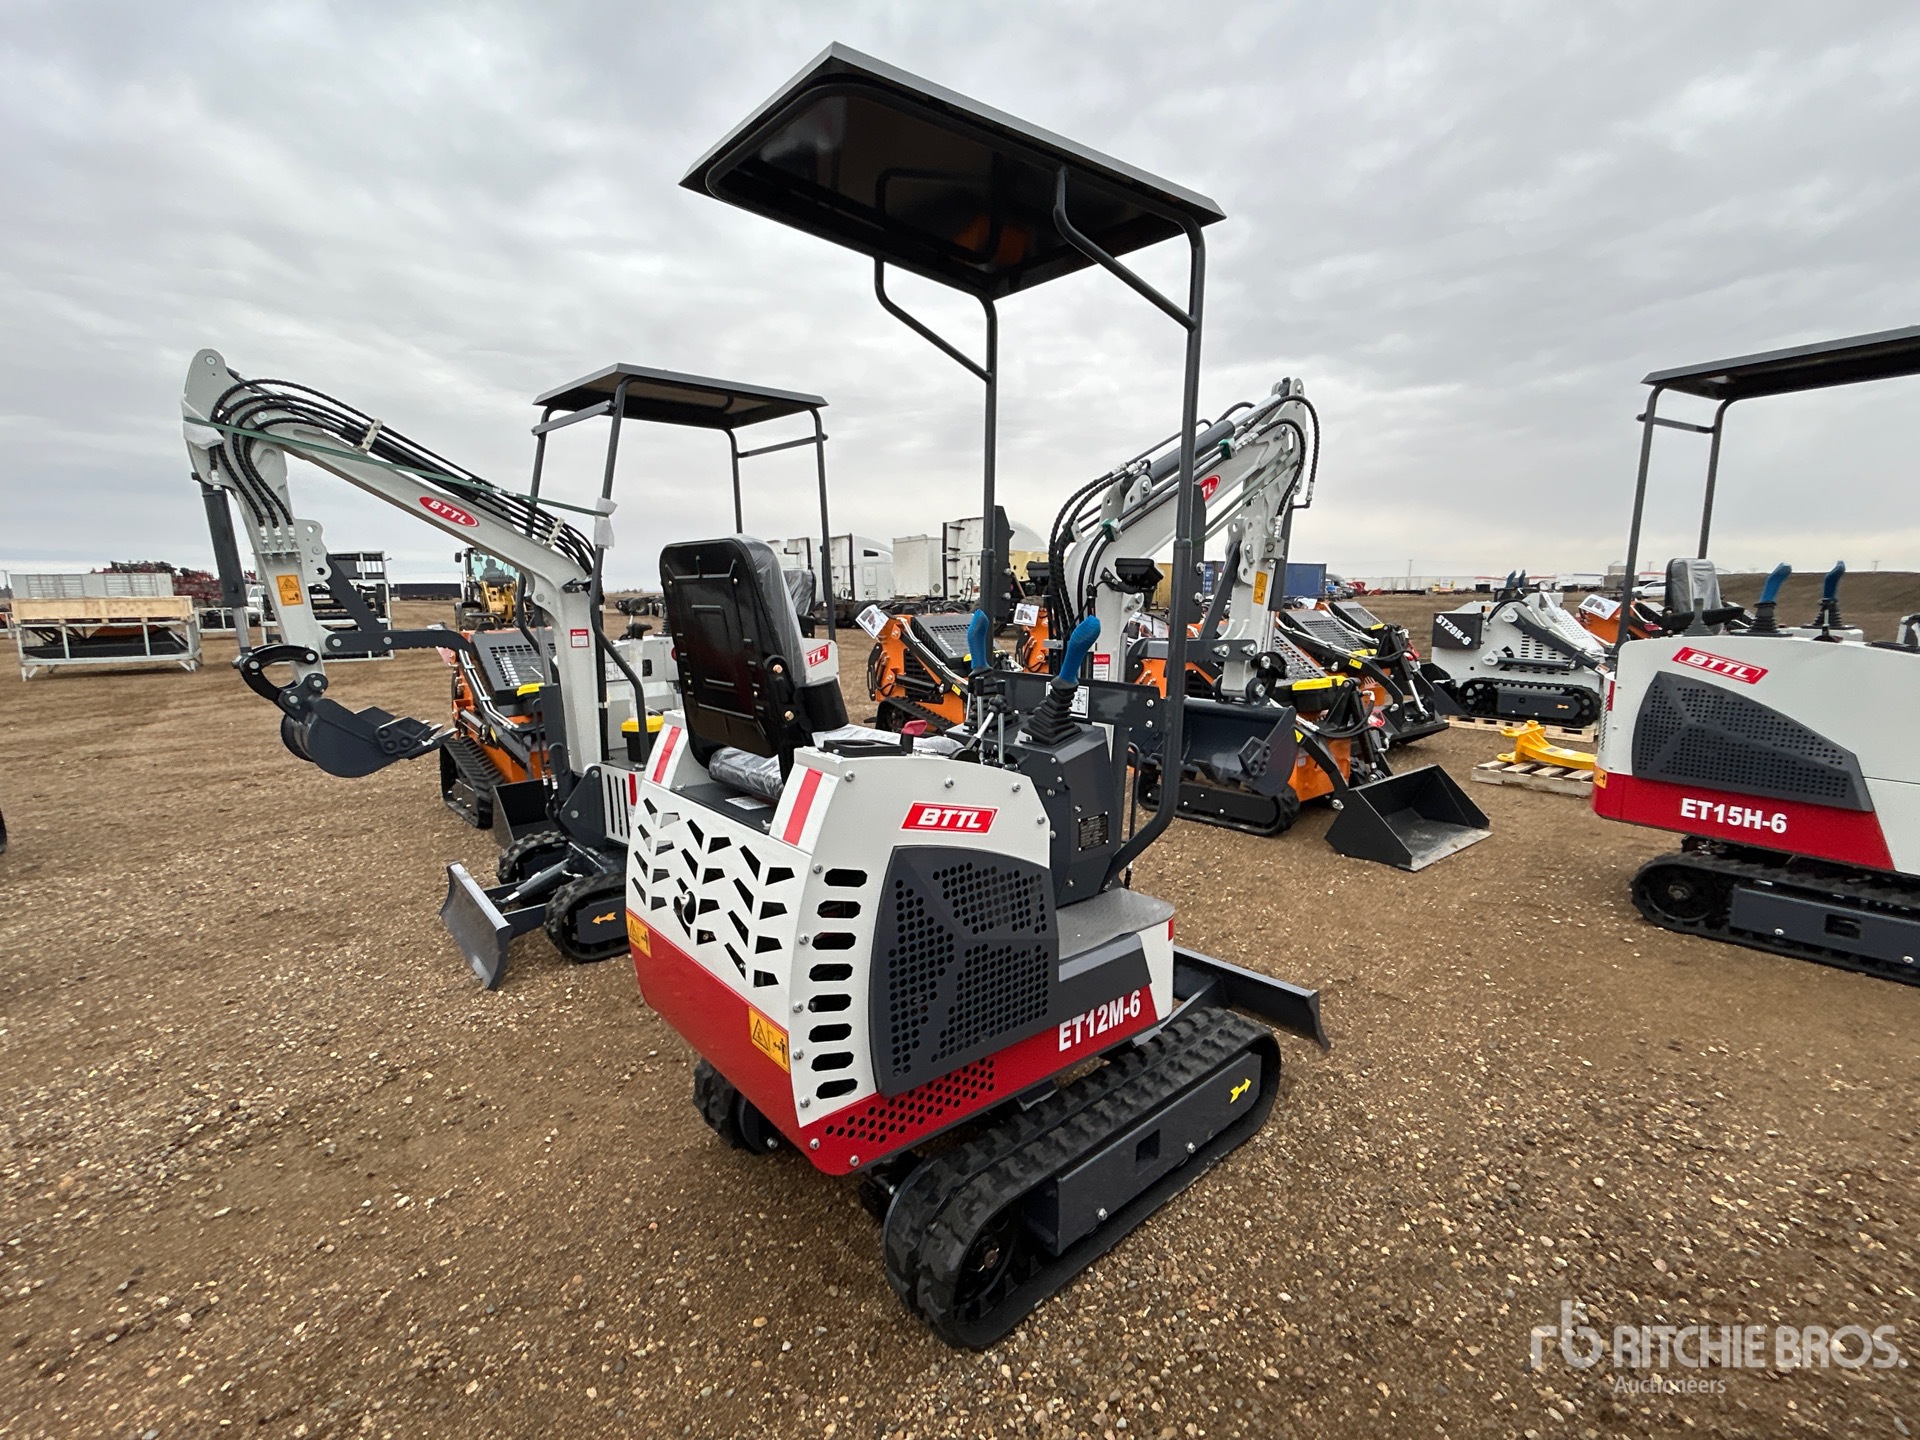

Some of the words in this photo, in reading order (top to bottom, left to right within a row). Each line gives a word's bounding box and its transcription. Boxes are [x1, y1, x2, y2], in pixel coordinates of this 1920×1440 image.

[1201, 482, 1214, 498] TL
[428, 500, 466, 524] BTTL
[1435, 614, 1472, 646] ST28H-6
[808, 650, 825, 663] TL
[1686, 653, 1749, 679] BTTL
[917, 807, 982, 829] BTTL
[1680, 797, 1788, 834] ET15H-6
[1058, 989, 1141, 1052] ET12M-6
